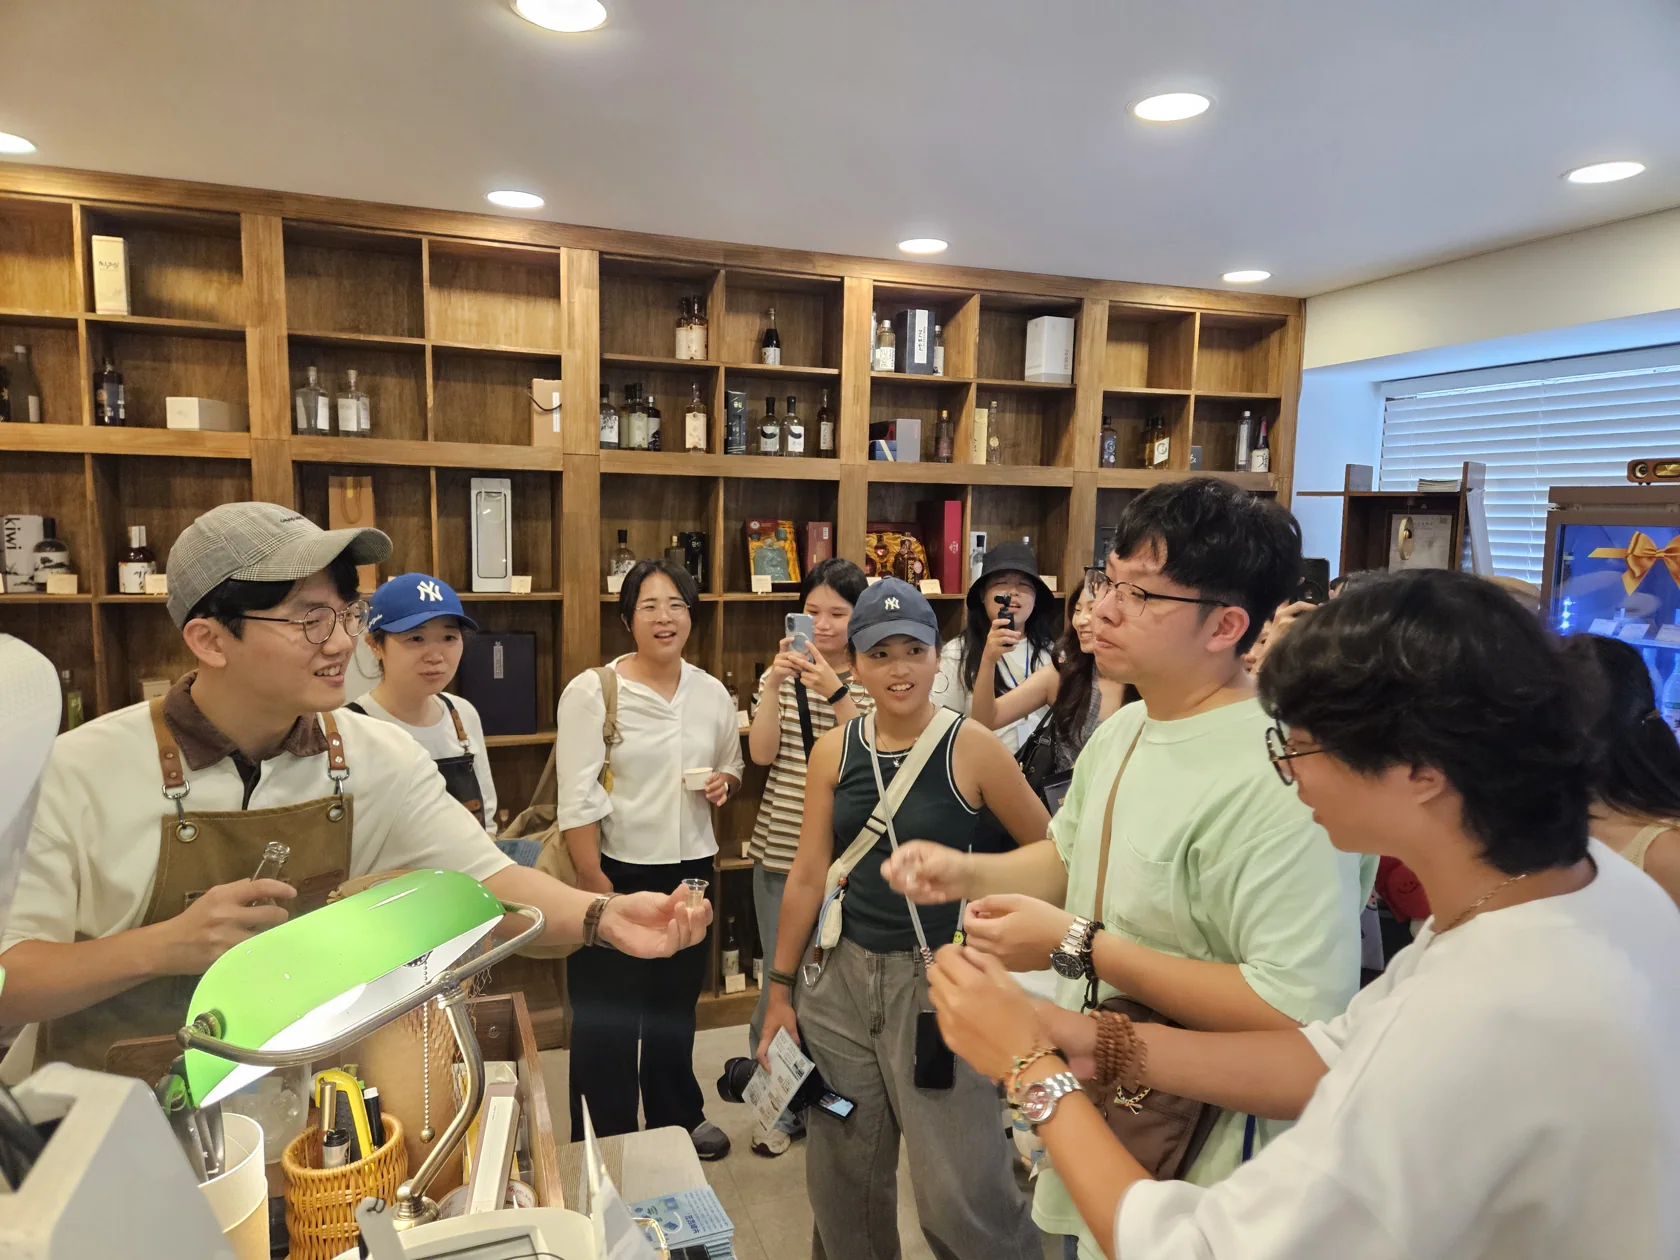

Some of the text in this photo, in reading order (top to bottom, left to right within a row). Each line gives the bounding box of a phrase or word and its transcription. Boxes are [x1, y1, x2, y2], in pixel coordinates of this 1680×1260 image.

[4, 517, 22, 550] kiwi
[416, 580, 443, 601] NY
[884, 596, 900, 610] NY
